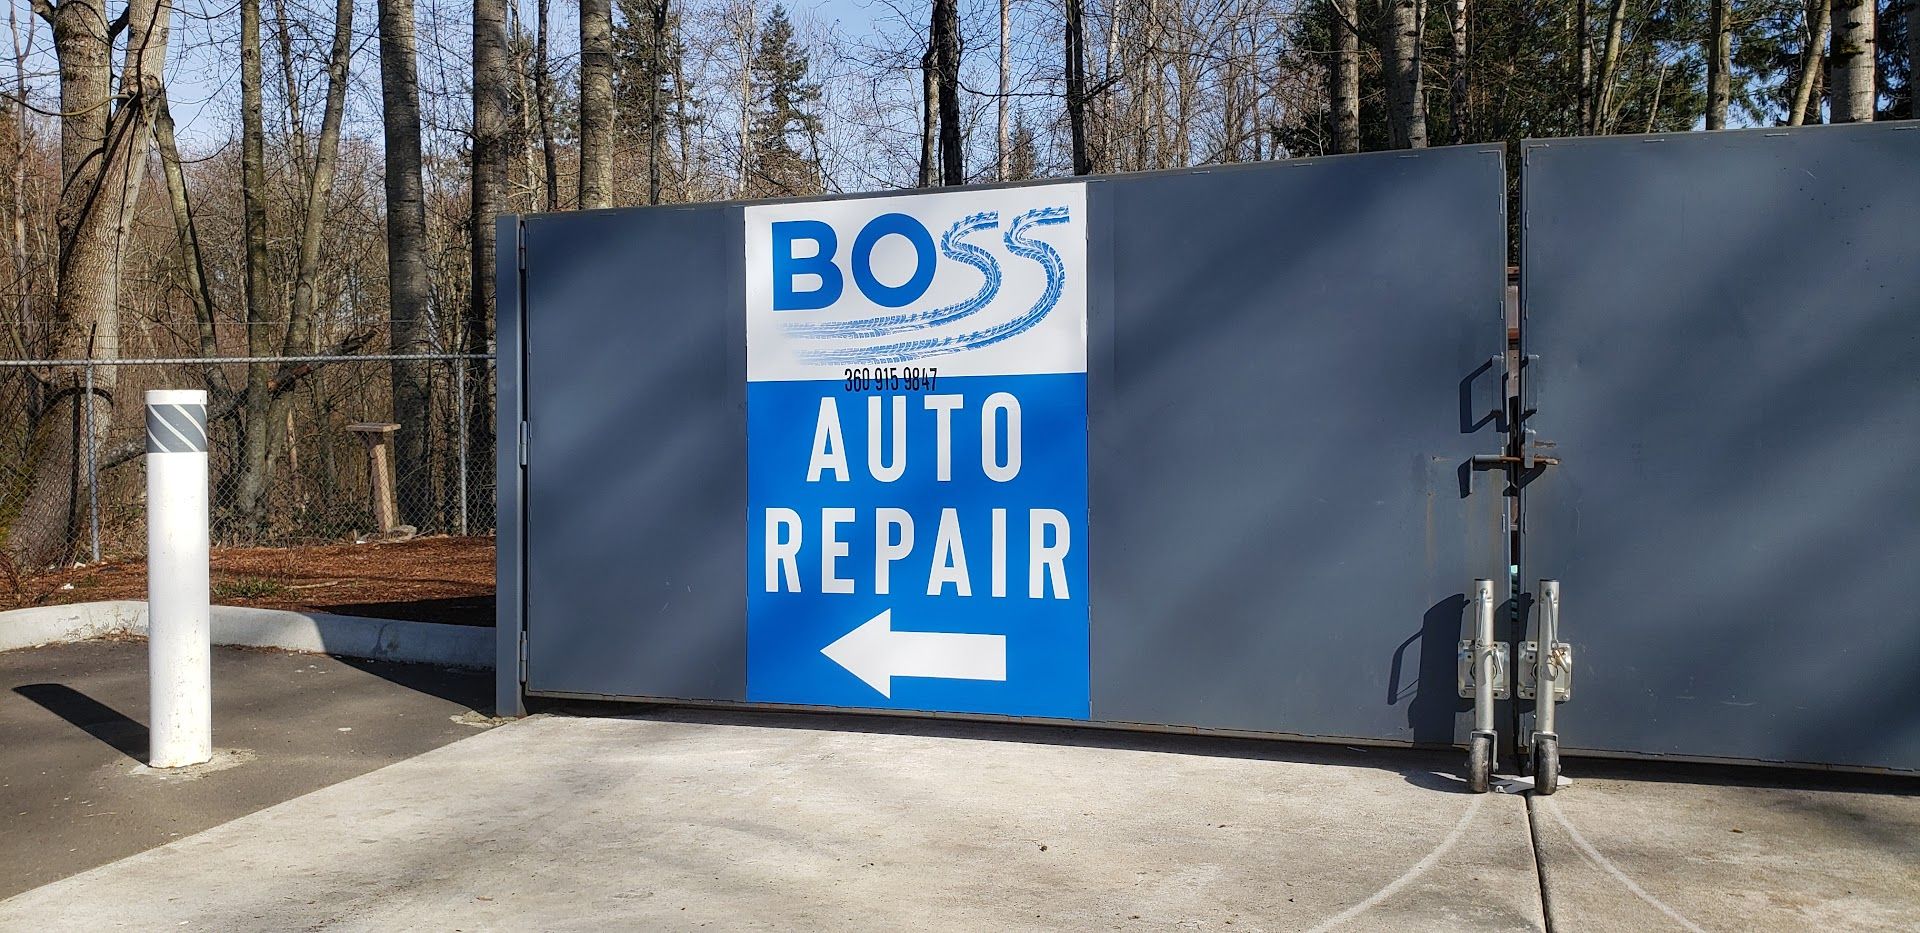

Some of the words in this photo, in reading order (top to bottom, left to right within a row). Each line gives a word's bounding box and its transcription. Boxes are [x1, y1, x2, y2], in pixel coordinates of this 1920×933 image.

[771, 205, 1070, 366] BOSS
[845, 367, 870, 392] 360
[874, 367, 898, 391] 915
[903, 366, 938, 391] 9847
[806, 392, 1022, 482] AUTO
[765, 507, 1071, 599] REPAIR
